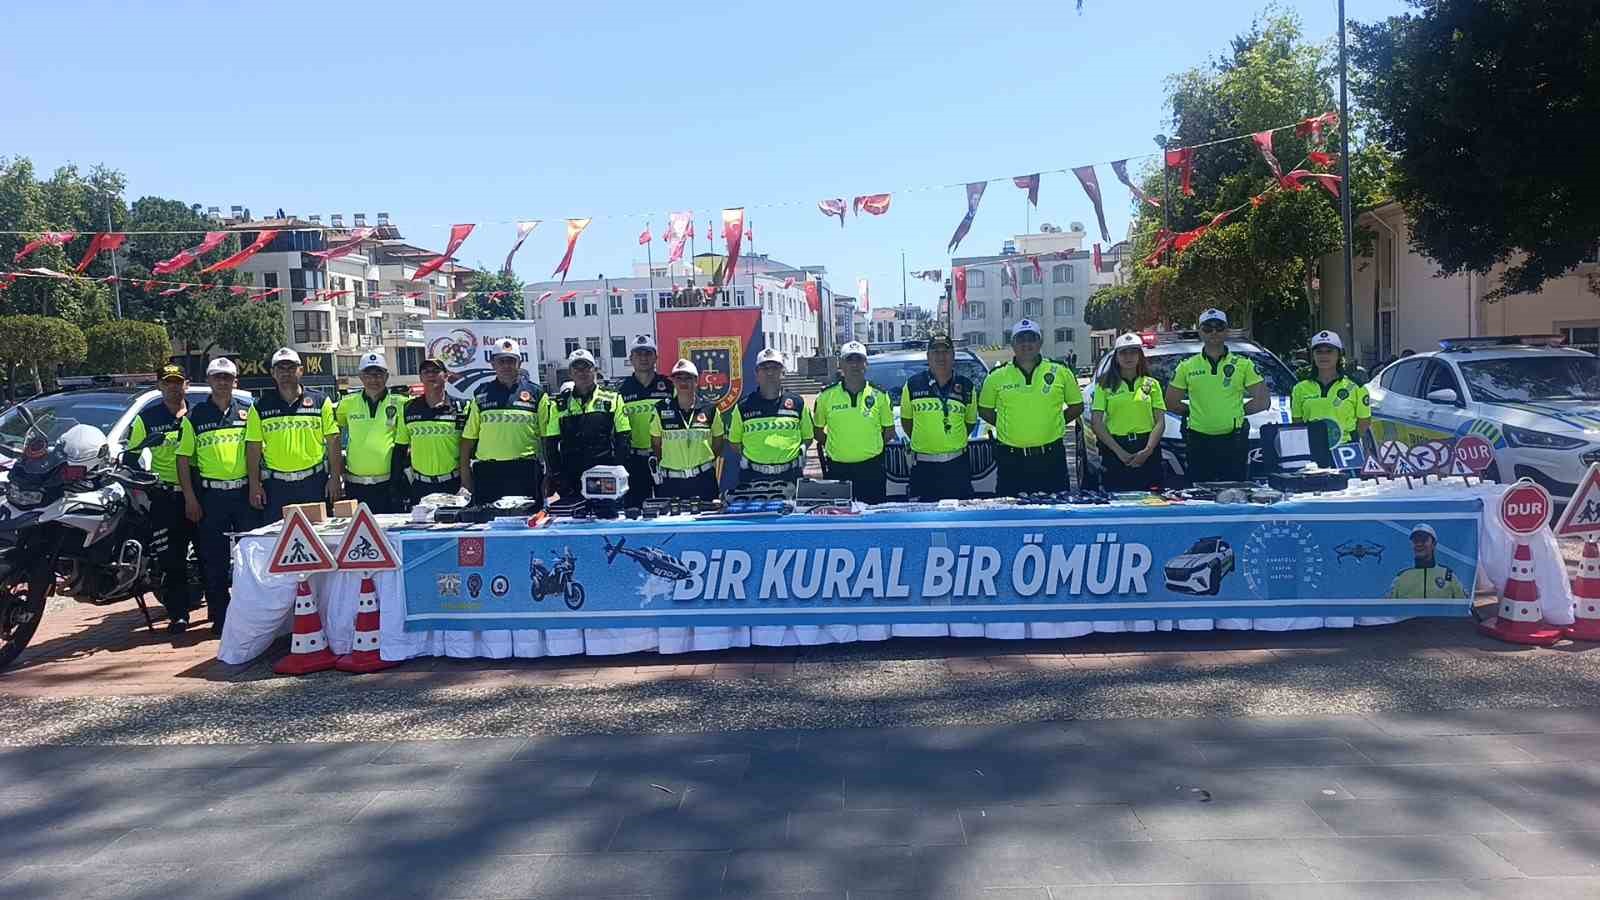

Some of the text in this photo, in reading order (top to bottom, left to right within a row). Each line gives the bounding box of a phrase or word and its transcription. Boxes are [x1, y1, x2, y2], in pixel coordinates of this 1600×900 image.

[1339, 447, 1356, 467] P
[1458, 444, 1490, 461] DUR
[1507, 503, 1543, 516] DUR
[759, 547, 909, 599] KURAL
[1012, 533, 1152, 596] ÖMÜR
